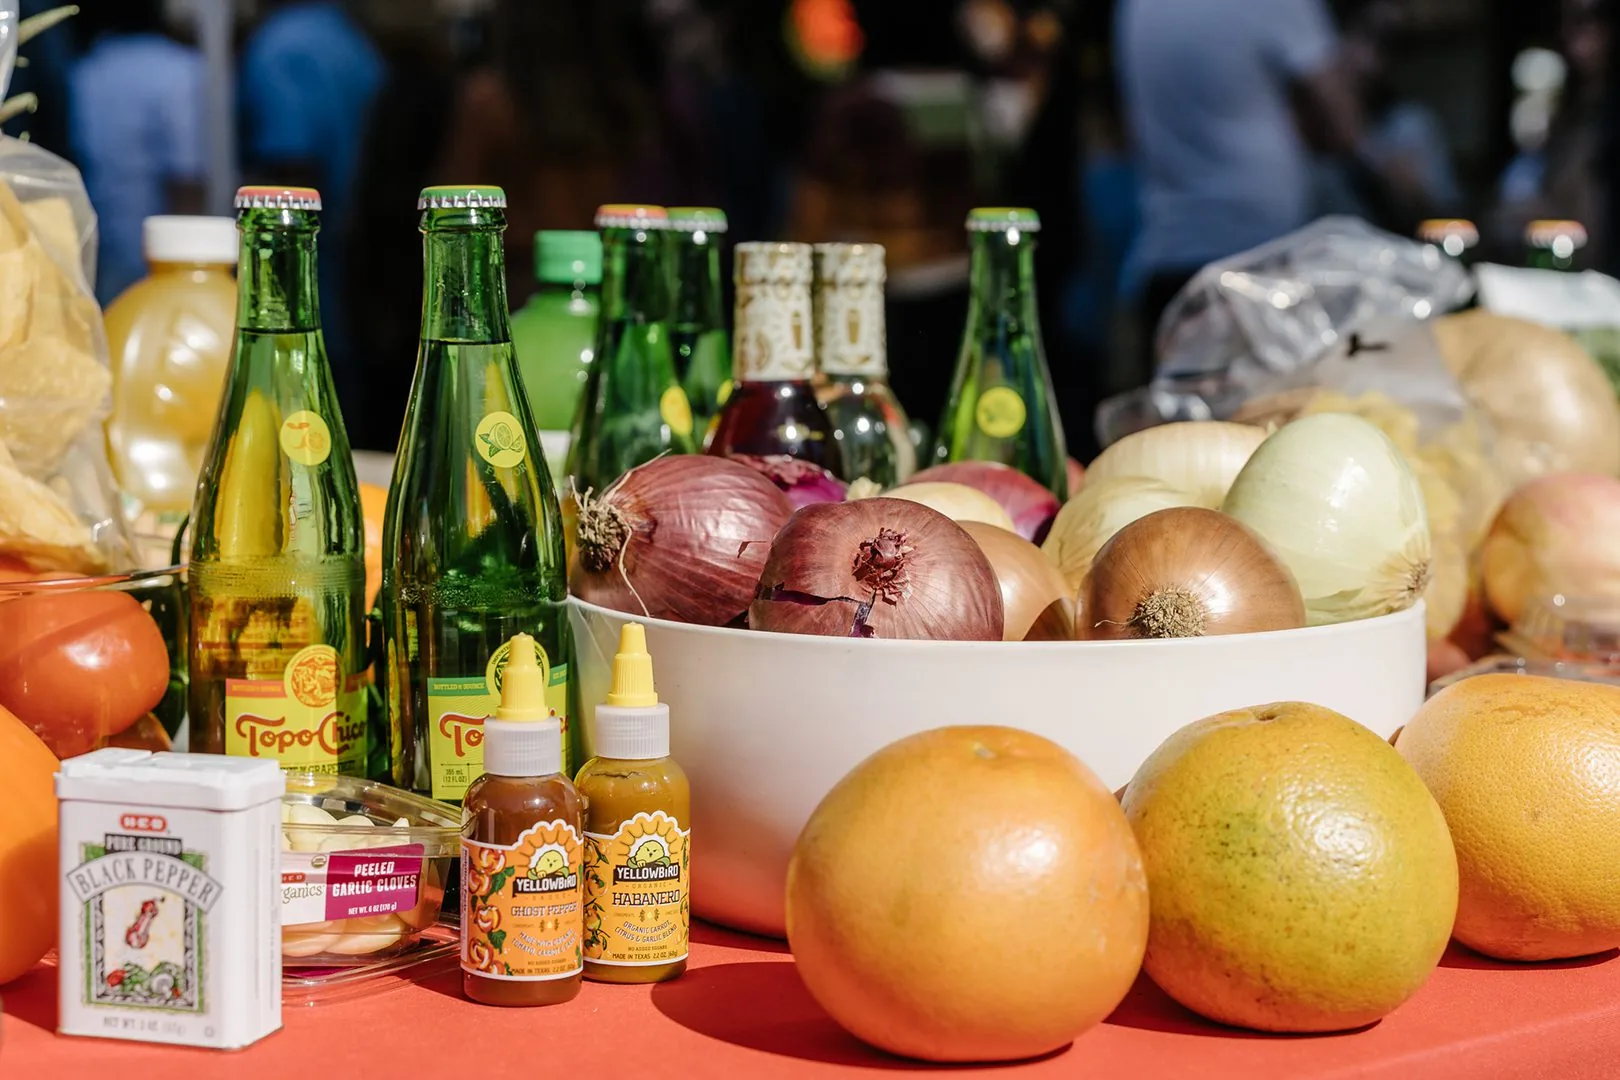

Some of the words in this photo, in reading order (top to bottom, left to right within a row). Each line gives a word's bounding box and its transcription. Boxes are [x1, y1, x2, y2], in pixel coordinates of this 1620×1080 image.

[236, 712, 314, 757] Topo
[318, 711, 367, 756] Chico
[439, 713, 485, 758] To
[354, 861, 395, 878] PEELED
[75, 857, 137, 895] BLACK
[143, 858, 215, 904] PEPPER
[332, 880, 373, 898] GARLIC
[376, 874, 417, 893] CLOVES
[612, 889, 680, 906] HABANERO
[348, 907, 358, 915] NET
[511, 905, 546, 917] GHOST
[615, 926, 635, 941] CITRUS
[642, 935, 662, 943] GARLIC
[662, 924, 678, 939] BLEND
[623, 921, 649, 935] ORGANIC
